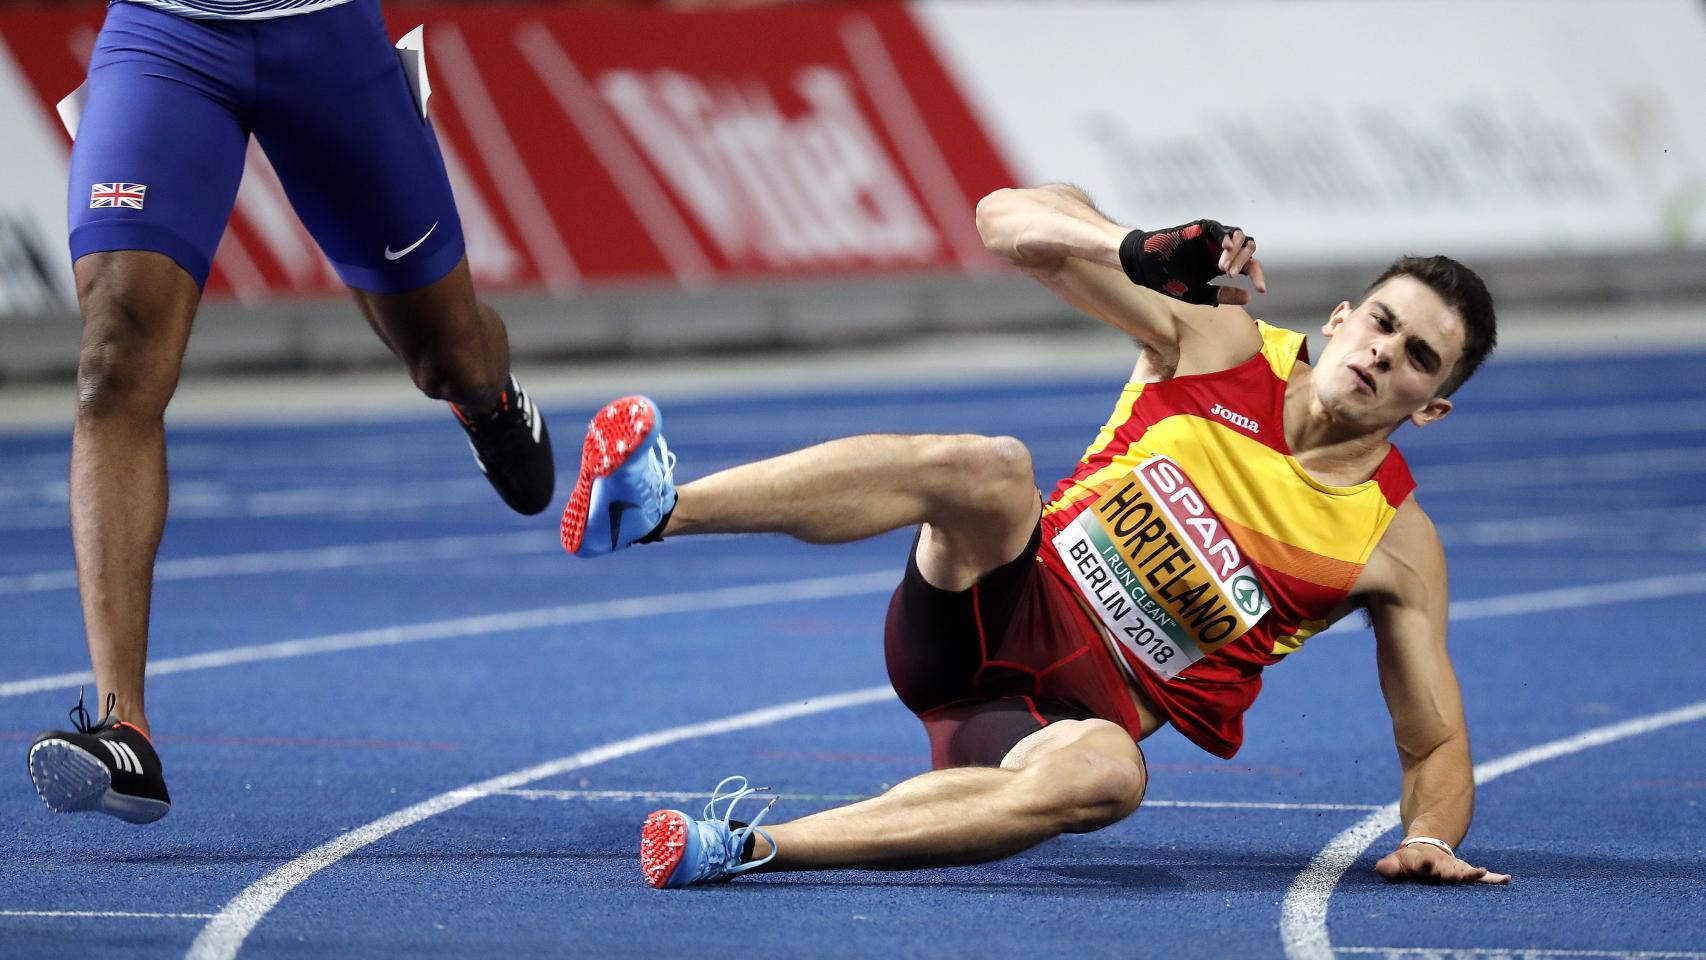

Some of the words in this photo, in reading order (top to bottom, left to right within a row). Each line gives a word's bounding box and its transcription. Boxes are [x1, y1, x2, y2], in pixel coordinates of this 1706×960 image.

[1100, 481, 1238, 644] HORTELANO
[1102, 546, 1110, 556] I
[1108, 553, 1136, 588] RUN
[1149, 462, 1242, 578] SPAR
[1069, 539, 1132, 621] BERLIN
[1124, 618, 1175, 665] 2018
